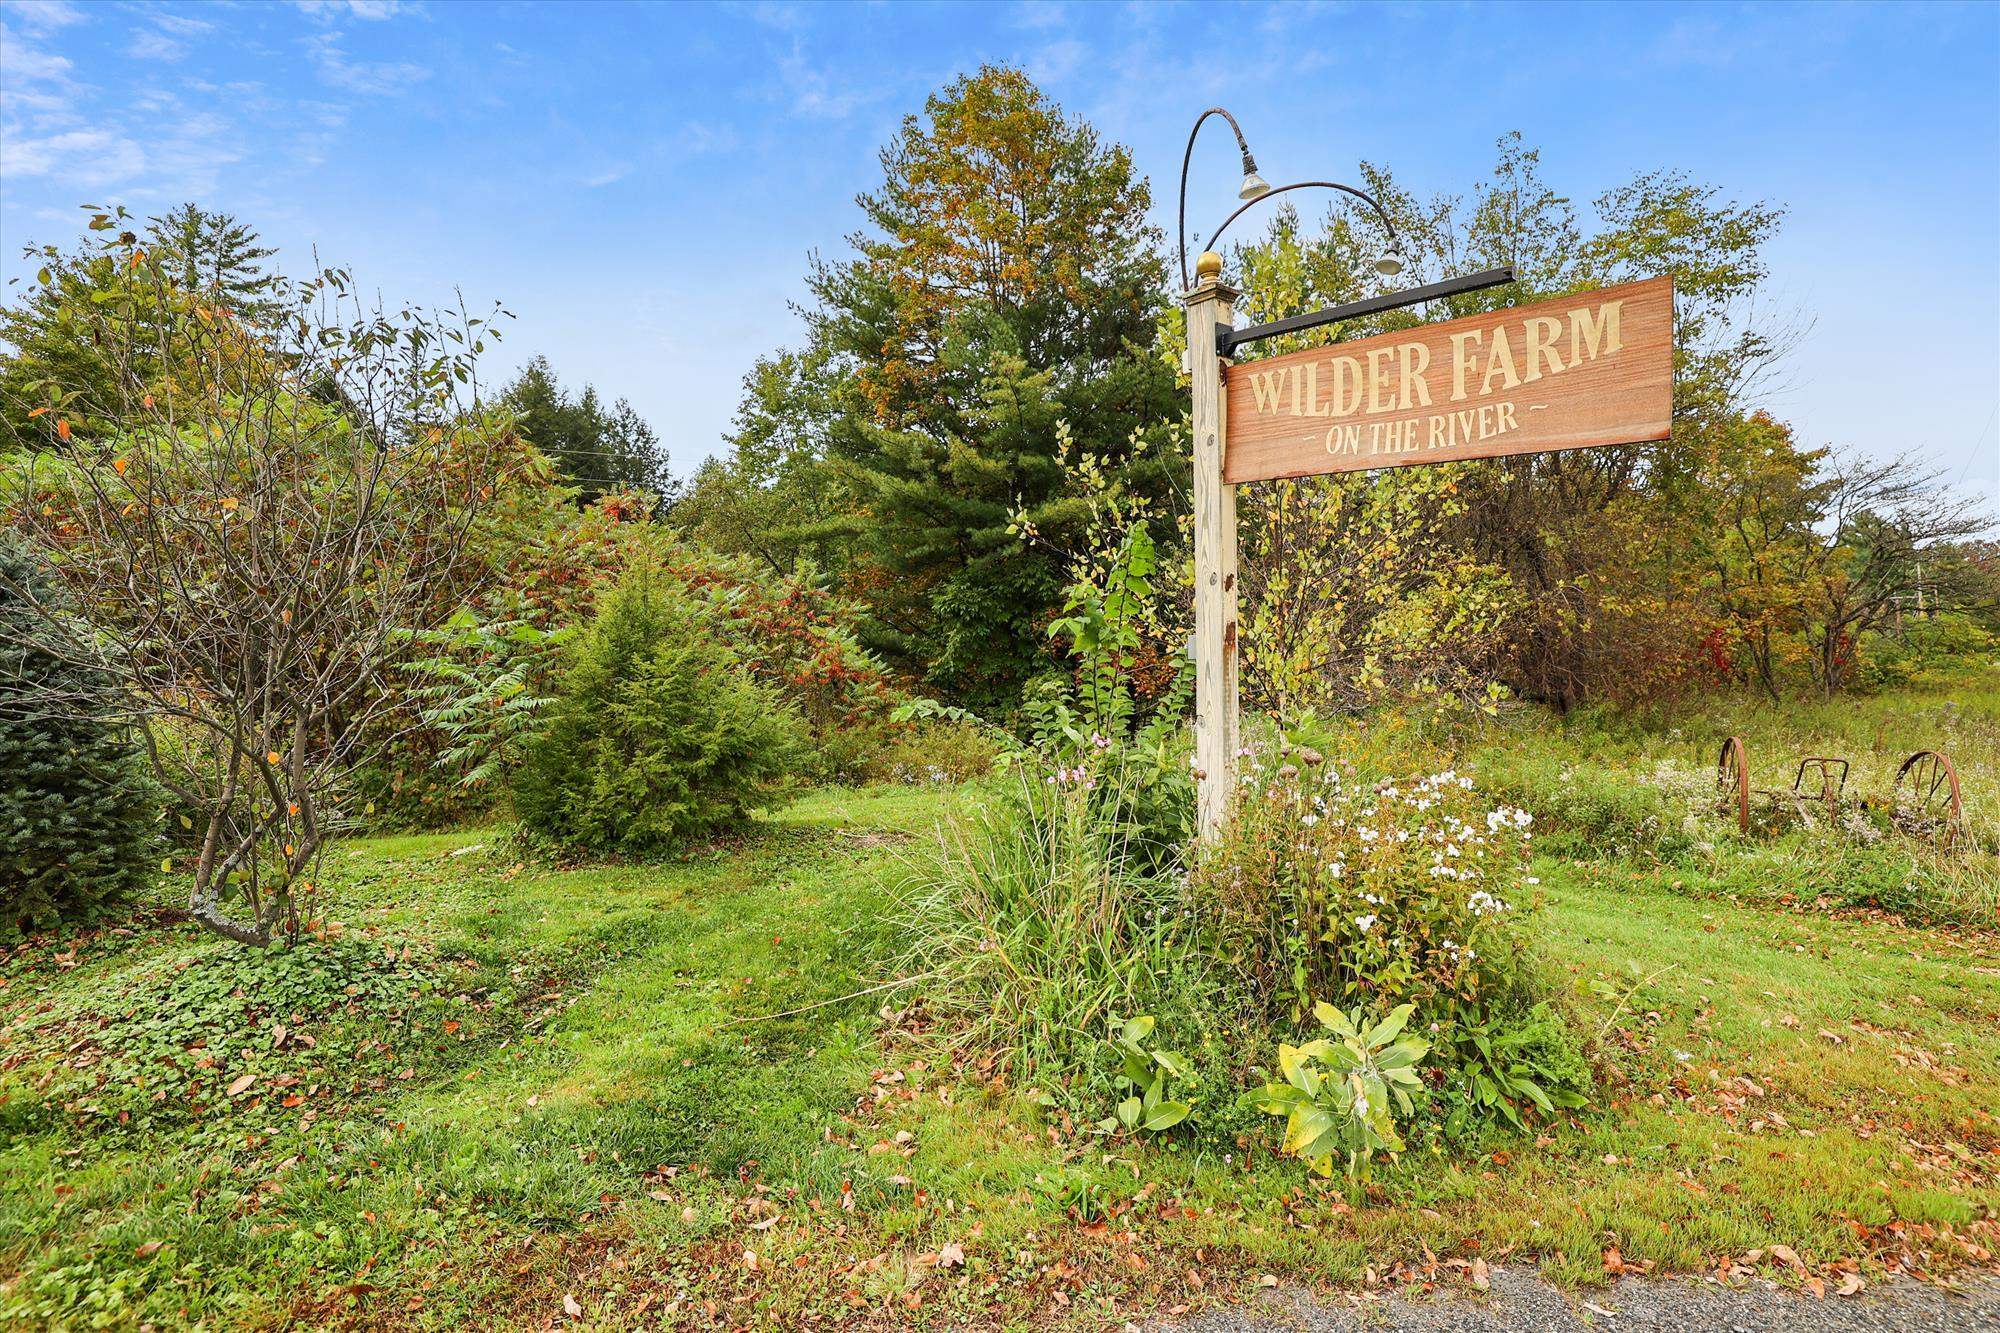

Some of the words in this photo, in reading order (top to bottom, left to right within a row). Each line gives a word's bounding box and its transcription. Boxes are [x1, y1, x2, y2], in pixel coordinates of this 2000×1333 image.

[1248, 341, 1432, 417] WILDER
[1449, 300, 1624, 401] FARM
[1326, 424, 1360, 455] ON
[1370, 418, 1420, 453] THE
[1428, 401, 1519, 449] RIVER
